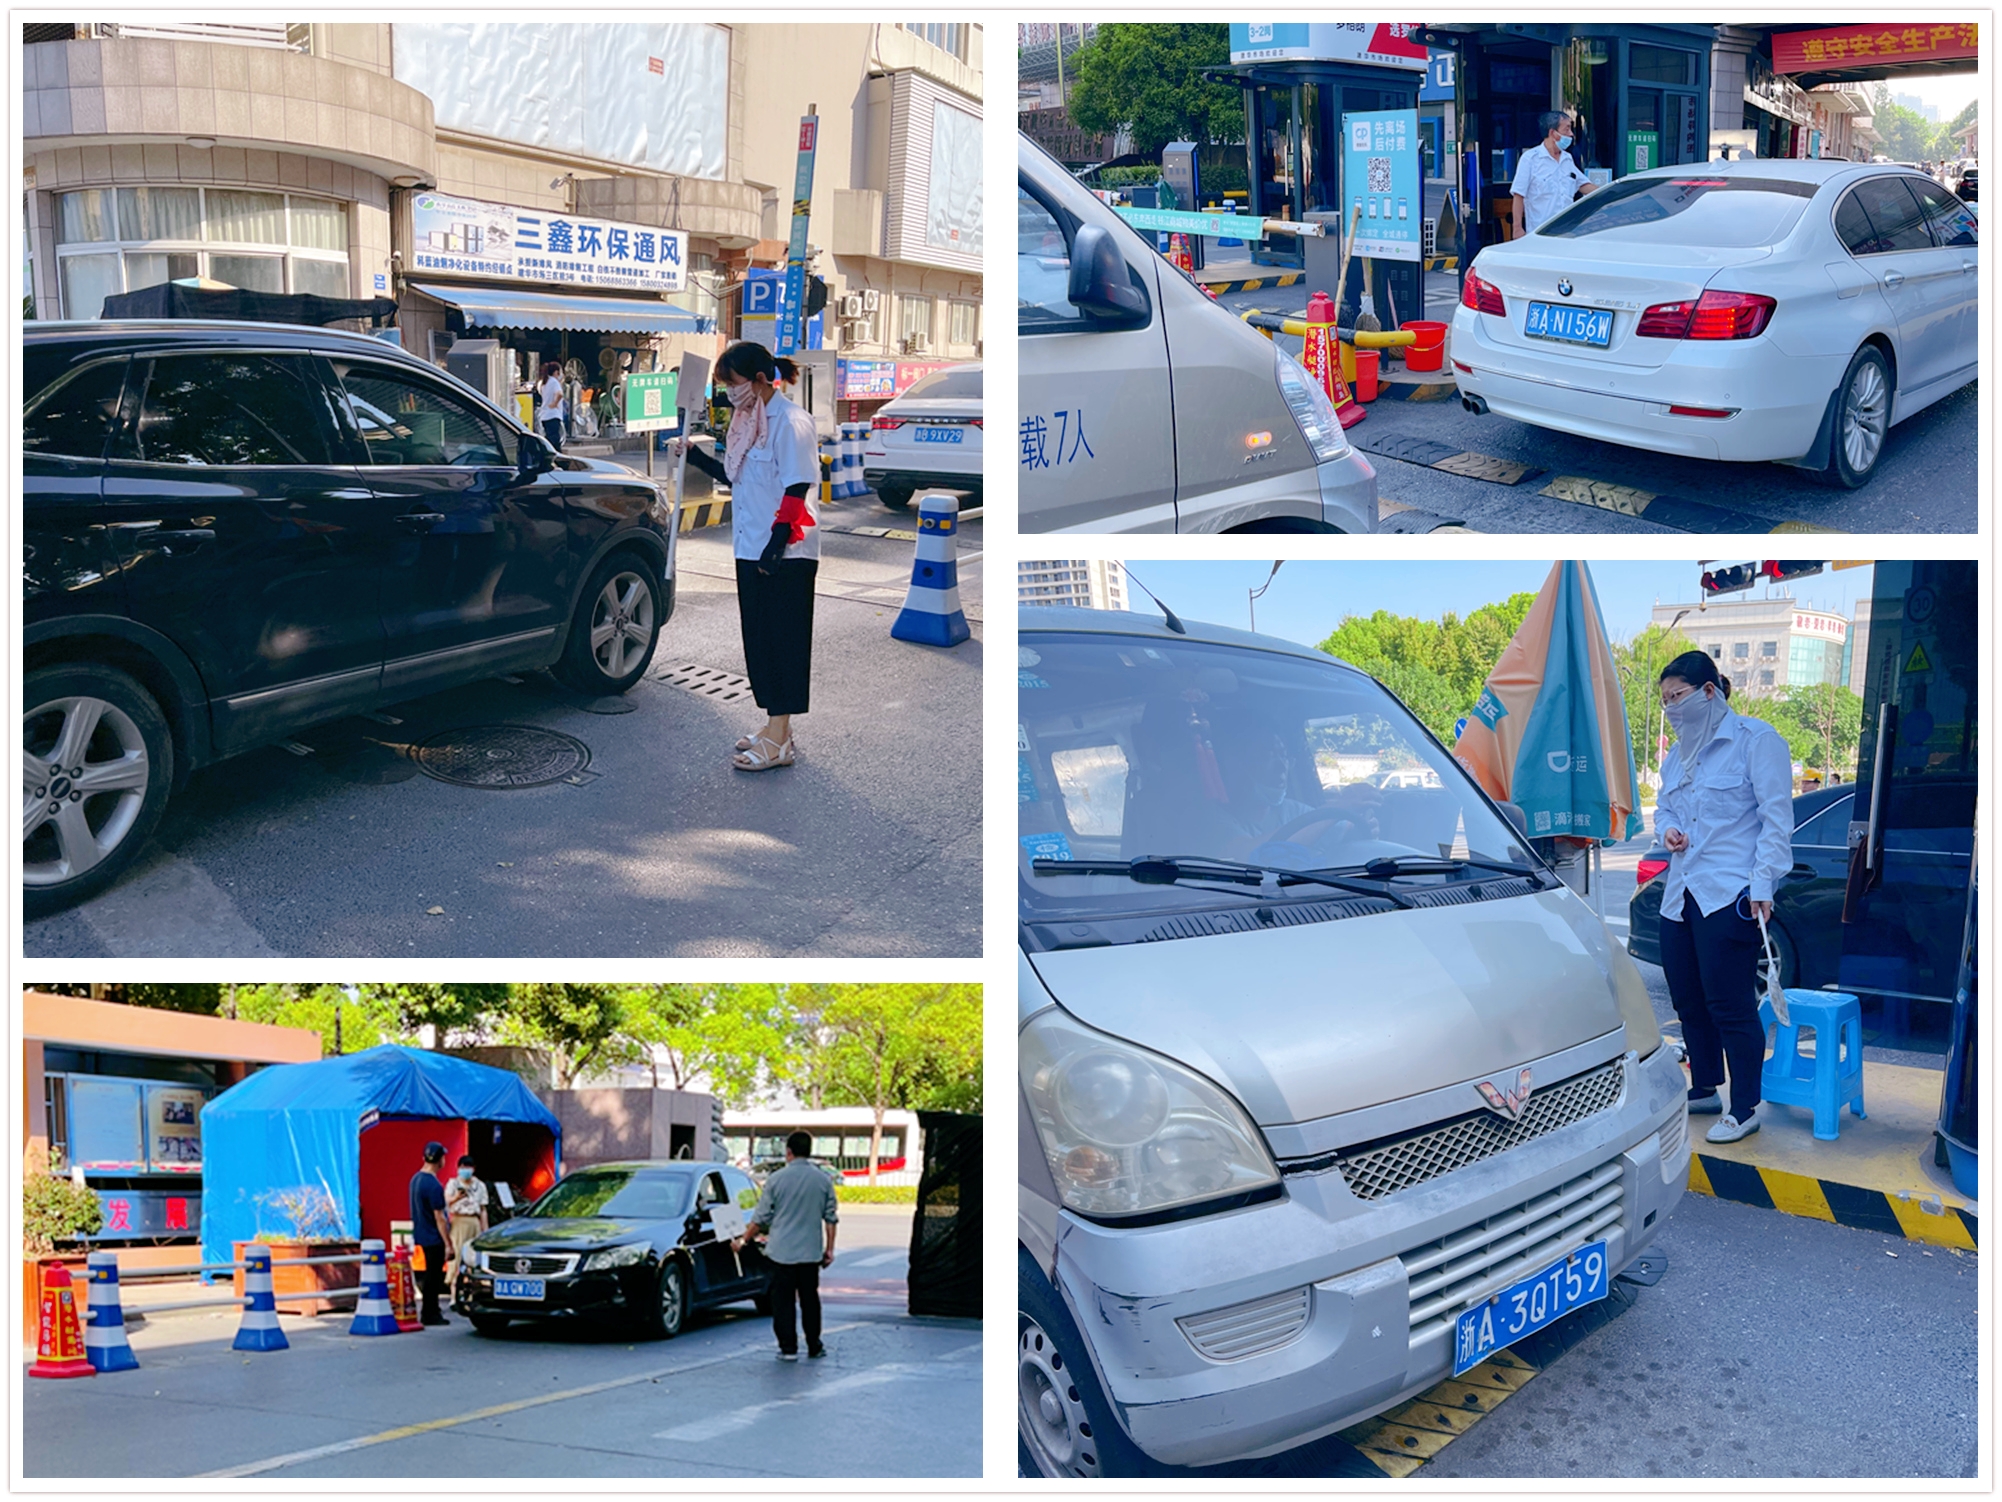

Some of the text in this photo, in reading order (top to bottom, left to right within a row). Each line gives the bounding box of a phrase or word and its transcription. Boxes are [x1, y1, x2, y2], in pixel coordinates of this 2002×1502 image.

[1802, 23, 1978, 62] 遵守安全生产法
[1374, 120, 1407, 135] 先离场
[1374, 136, 1407, 152] 后付费
[515, 216, 681, 266] 三鑫环保通风
[750, 281, 771, 312] P
[1019, 408, 1095, 471] 载7人
